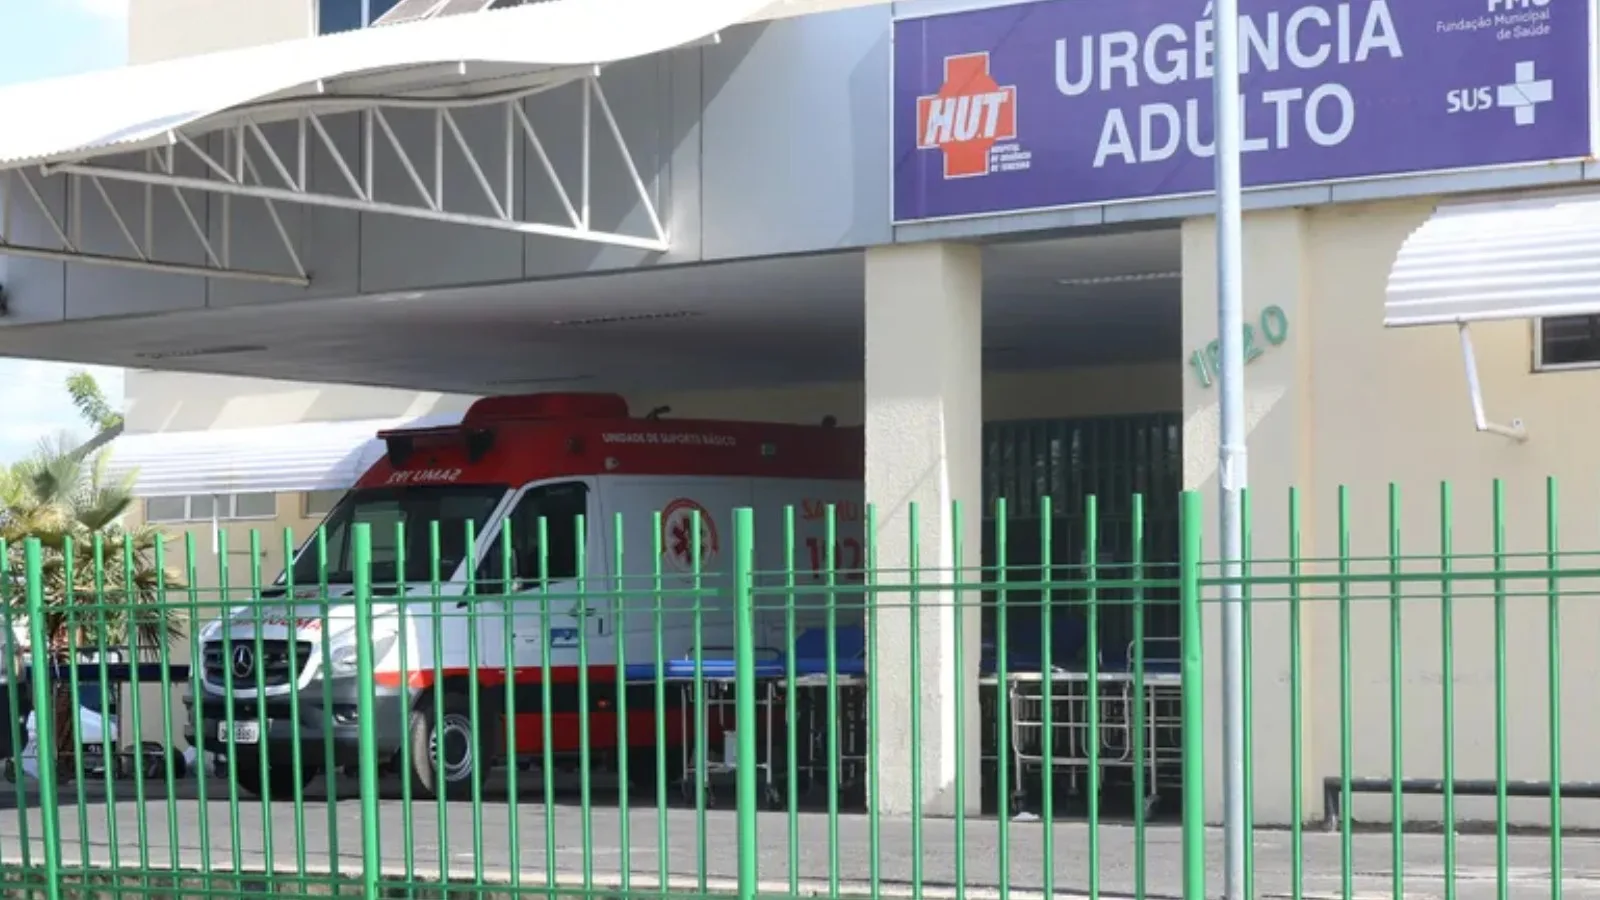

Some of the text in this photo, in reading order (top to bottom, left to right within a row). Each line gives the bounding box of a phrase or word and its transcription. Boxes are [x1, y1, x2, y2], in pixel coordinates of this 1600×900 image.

[1494, 8, 1551, 26] Municipal
[1496, 28, 1512, 41] de
[1446, 86, 1492, 114] SUS
[1092, 82, 1355, 168] ADULTO
